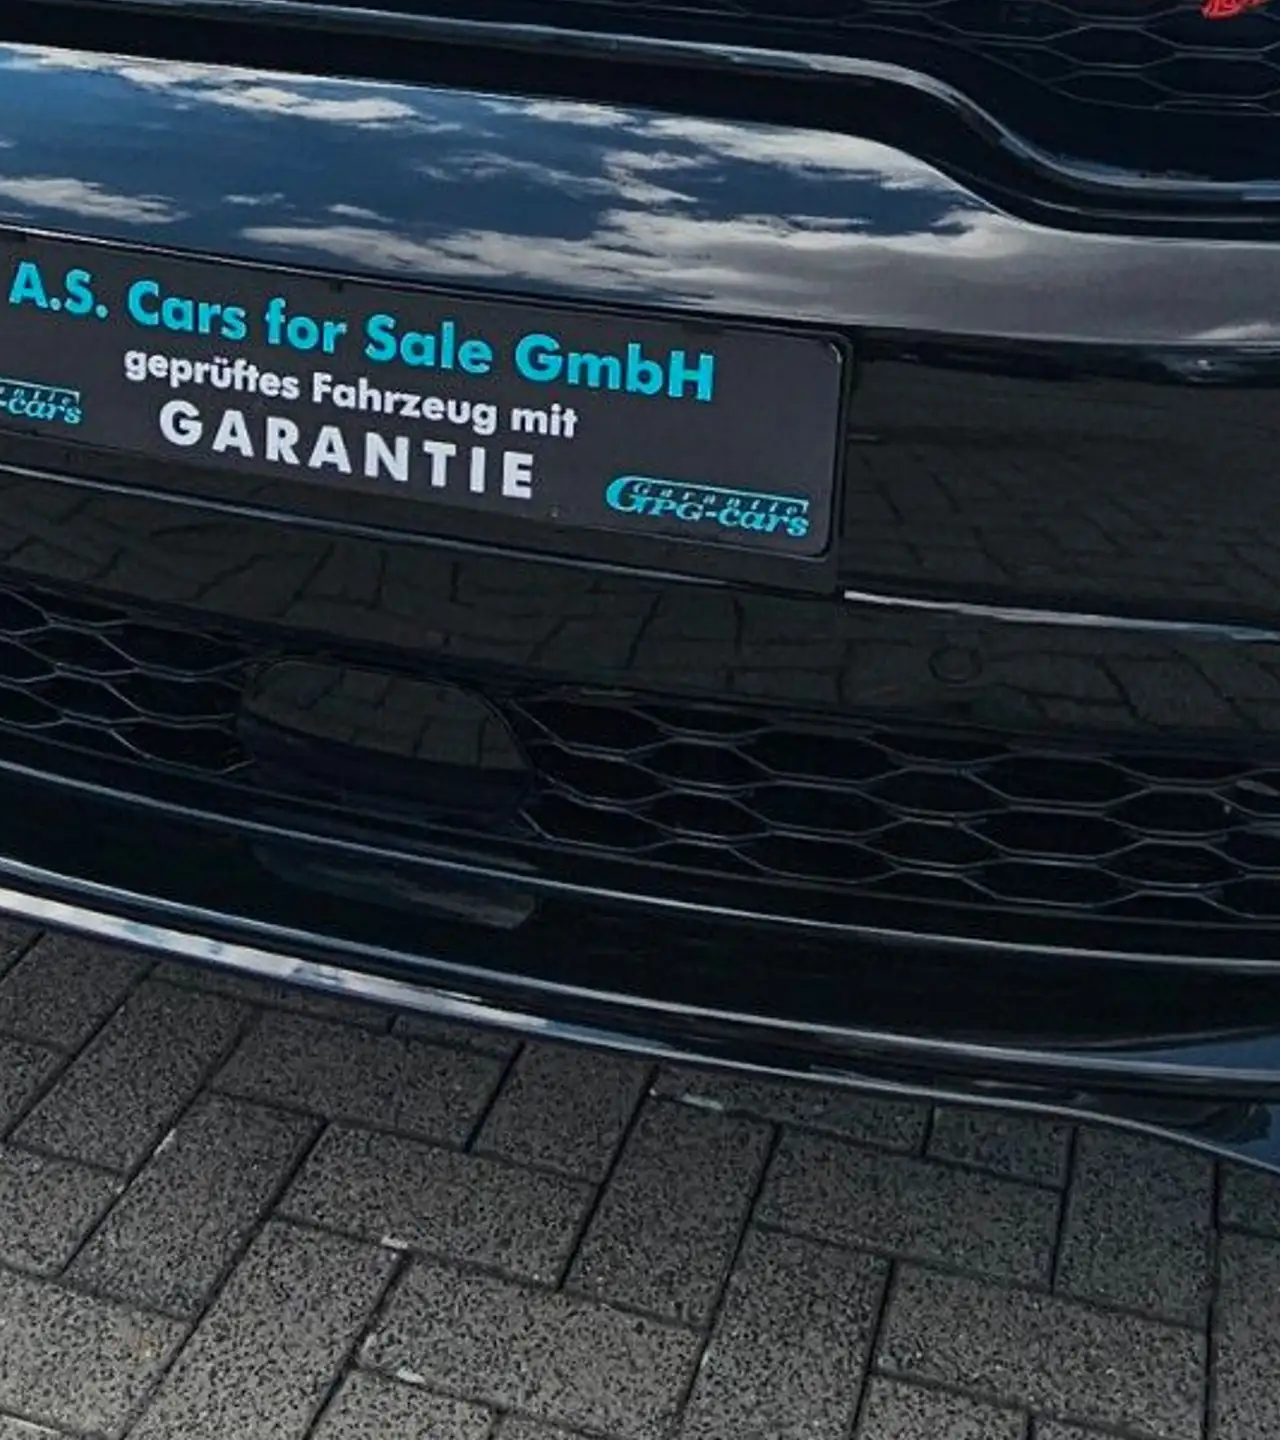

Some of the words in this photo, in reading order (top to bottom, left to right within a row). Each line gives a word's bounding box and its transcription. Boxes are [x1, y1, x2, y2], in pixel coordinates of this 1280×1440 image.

[9, 261, 109, 319] A.S.
[128, 280, 247, 340] Cars
[266, 297, 347, 353] for
[365, 314, 493, 374] Sale
[515, 333, 714, 401] GmbH
[124, 349, 300, 400] geprüftes
[312, 371, 497, 436] Fahrzeug
[511, 402, 578, 438] mit
[159, 399, 534, 500] GARANTIE
